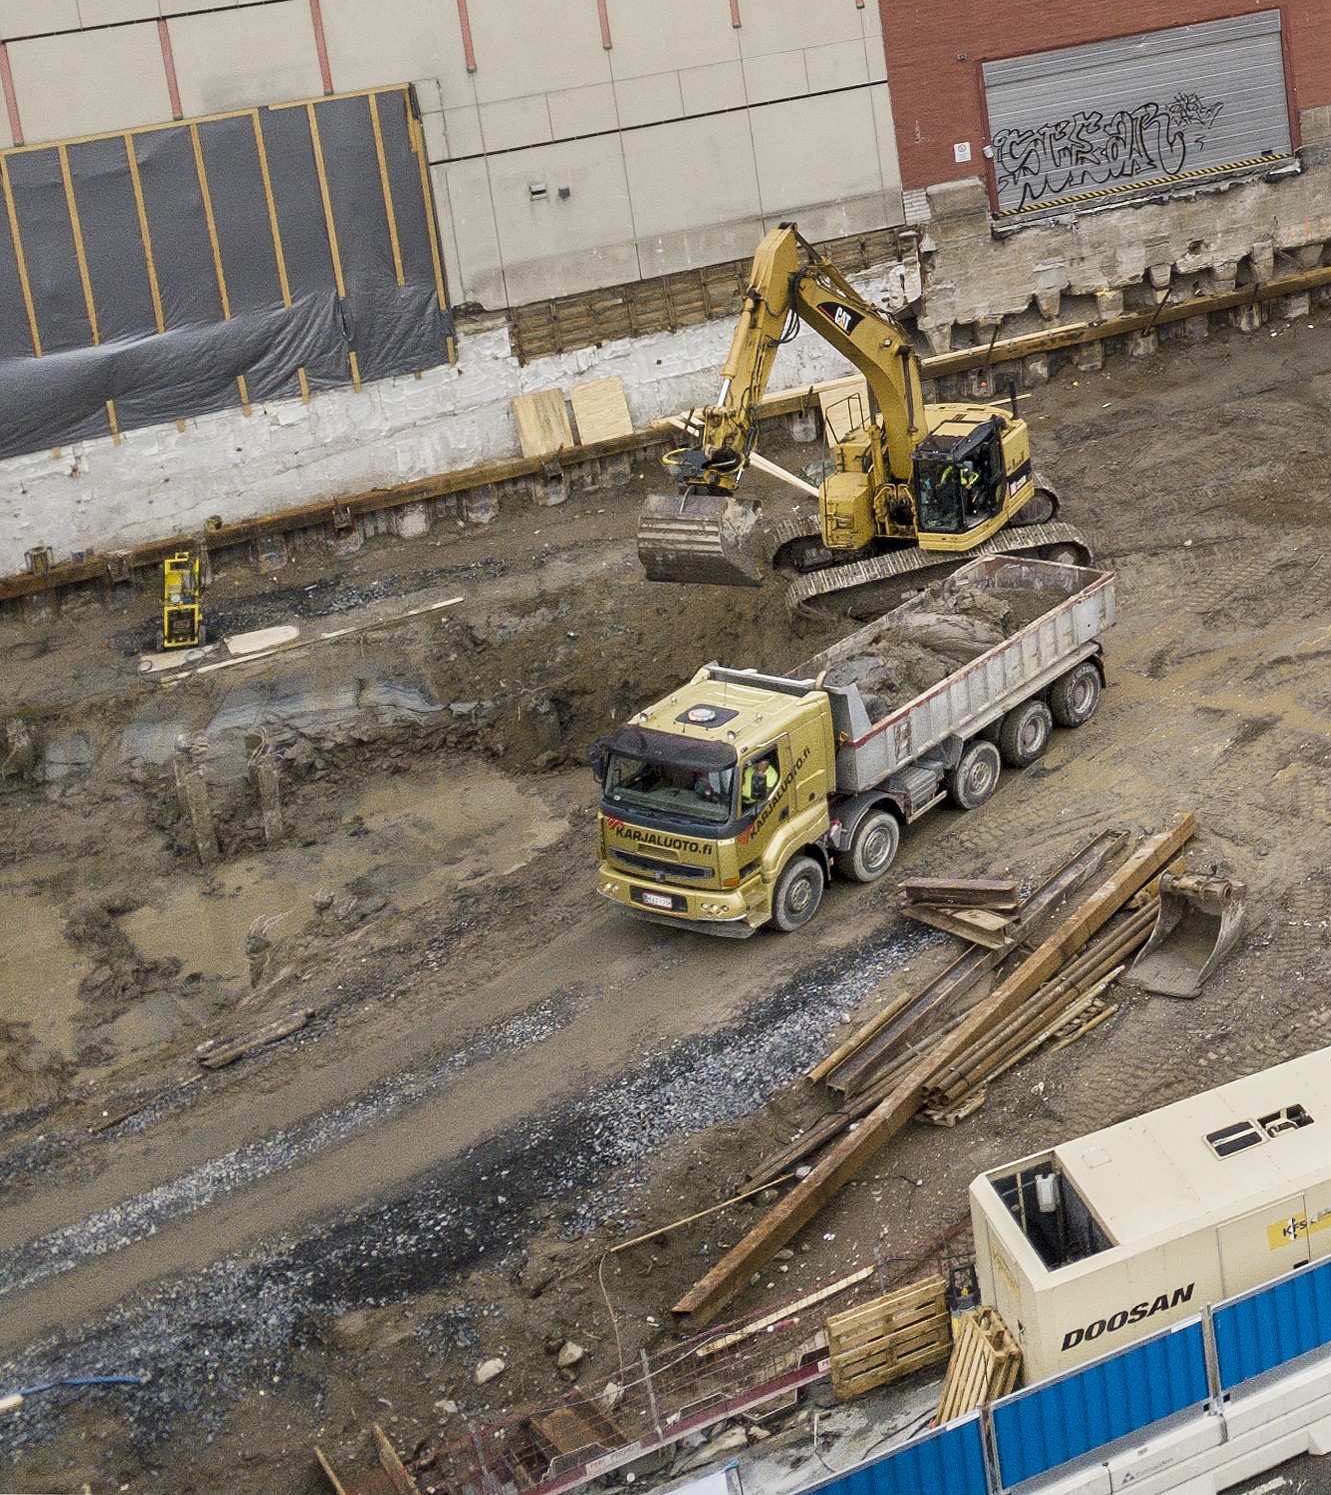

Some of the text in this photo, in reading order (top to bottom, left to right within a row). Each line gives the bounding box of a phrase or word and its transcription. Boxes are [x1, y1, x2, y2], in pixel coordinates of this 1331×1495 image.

[834, 306, 852, 331] CAT
[750, 745, 811, 840] KARJALUOTO.fi
[615, 826, 713, 855] KARJALUOTO.fi
[1061, 1282, 1195, 1352] DOOSAN
